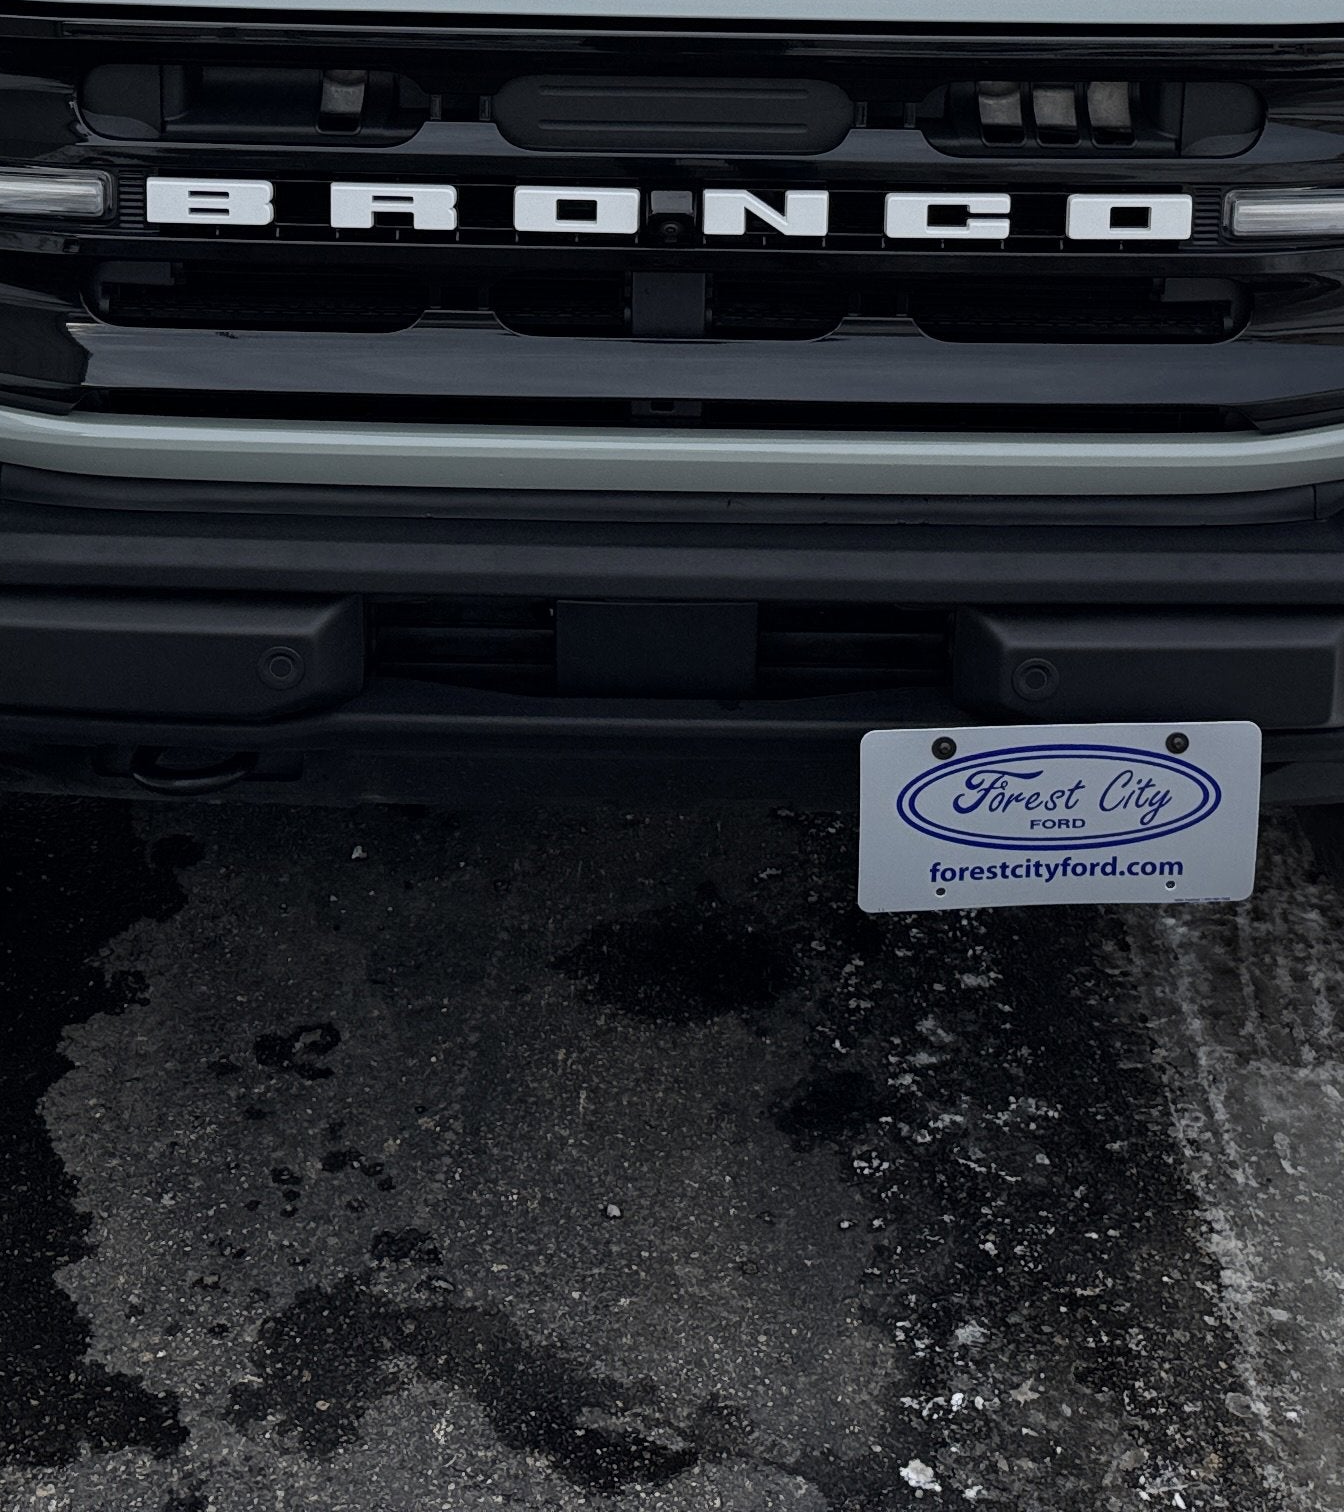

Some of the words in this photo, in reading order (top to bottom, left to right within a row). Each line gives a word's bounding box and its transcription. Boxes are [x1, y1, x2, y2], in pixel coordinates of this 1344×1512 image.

[146, 175, 1194, 241] BRONCO
[952, 769, 1086, 814] Forest
[1099, 769, 1173, 826] City
[1029, 818, 1086, 830] FORD
[929, 856, 1184, 884] forestcityford.com
